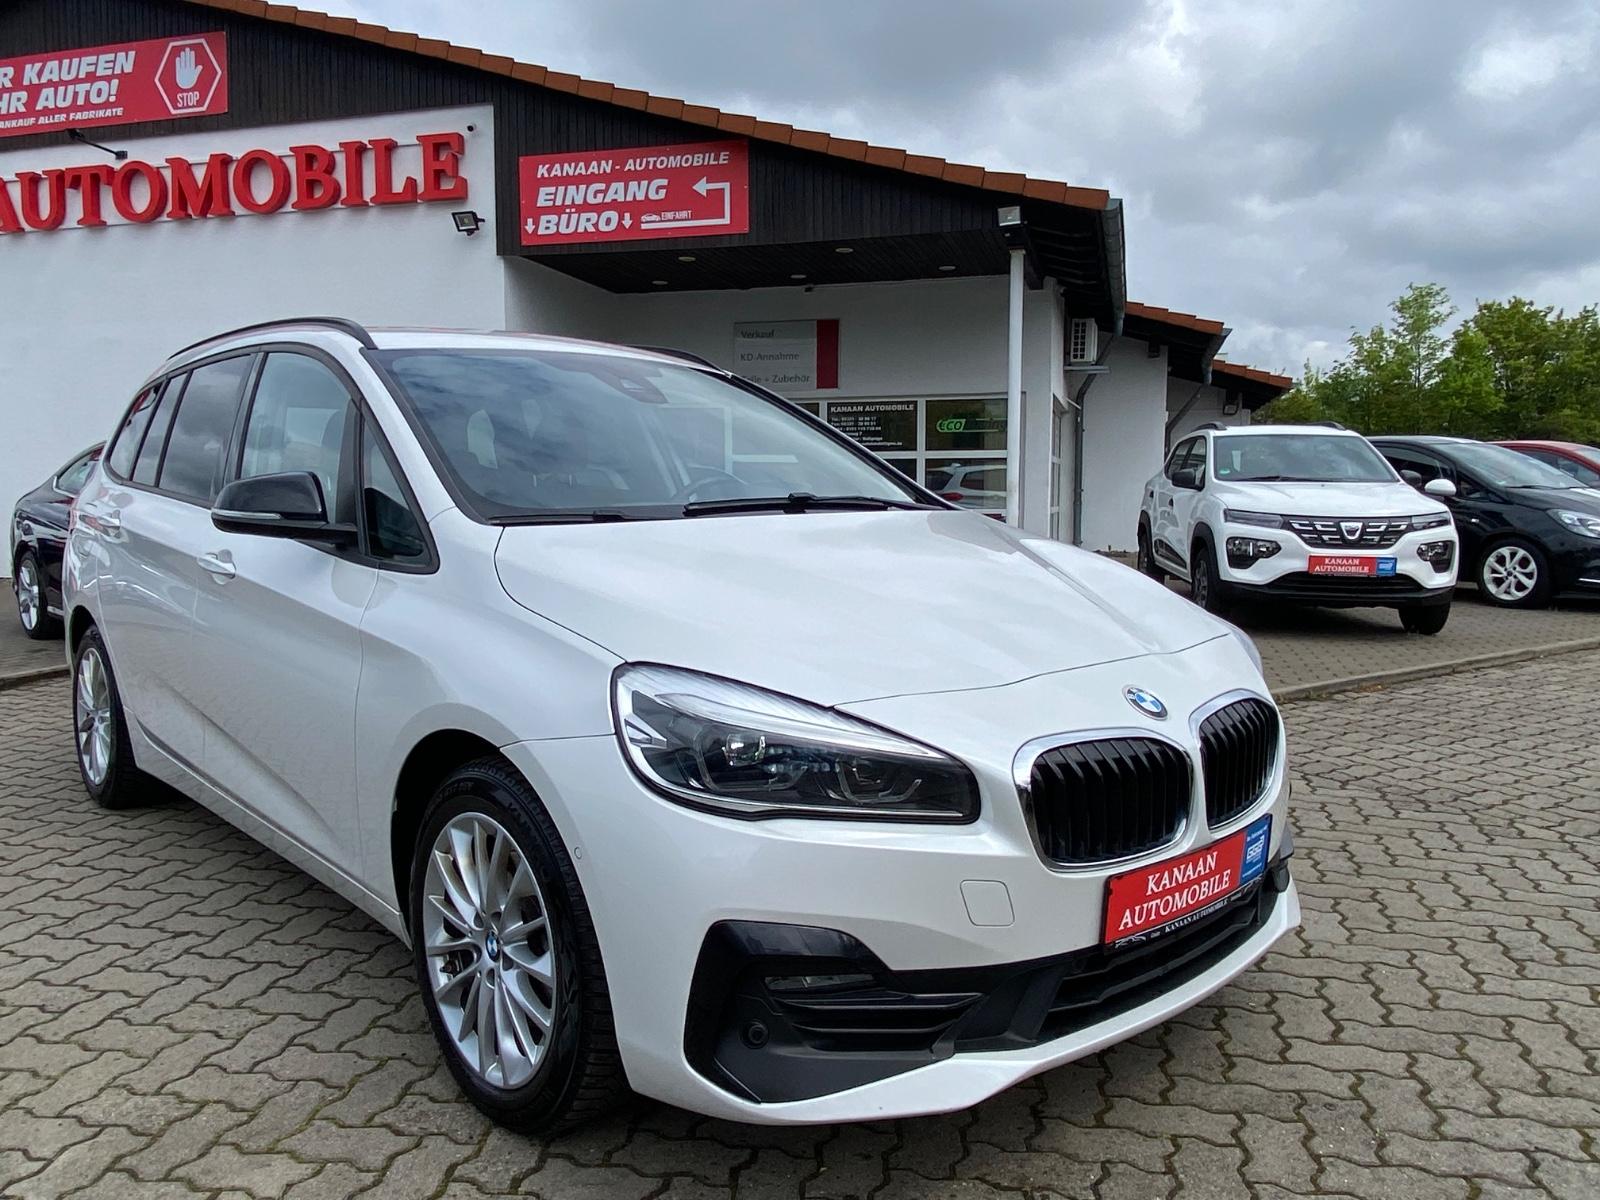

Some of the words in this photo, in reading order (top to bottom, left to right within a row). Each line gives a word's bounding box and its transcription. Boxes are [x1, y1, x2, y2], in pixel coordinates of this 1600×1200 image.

[23, 51, 136, 85] KAUFEN
[35, 79, 119, 111] AUTO!
[176, 91, 200, 107] STOP
[38, 114, 66, 124] ALLER
[69, 108, 124, 120] FABRIKATE
[537, 160, 613, 178] KANAAN
[624, 152, 730, 171] AUTOMOBILE
[0, 132, 468, 232] AUTOMOBILE
[536, 178, 669, 207] EINGANG
[537, 209, 619, 235] BÜRO
[661, 210, 692, 221] EINFAHRT
[740, 329, 775, 339] Verkauf
[830, 405, 863, 413] KANAAN
[864, 404, 914, 412] AUTOMOBILE
[1314, 564, 1370, 573] AUTOMOBILE
[1324, 557, 1360, 565] KANAAN
[1145, 851, 1219, 896] KANAAN
[1118, 869, 1231, 931] AUTOMOBILE
